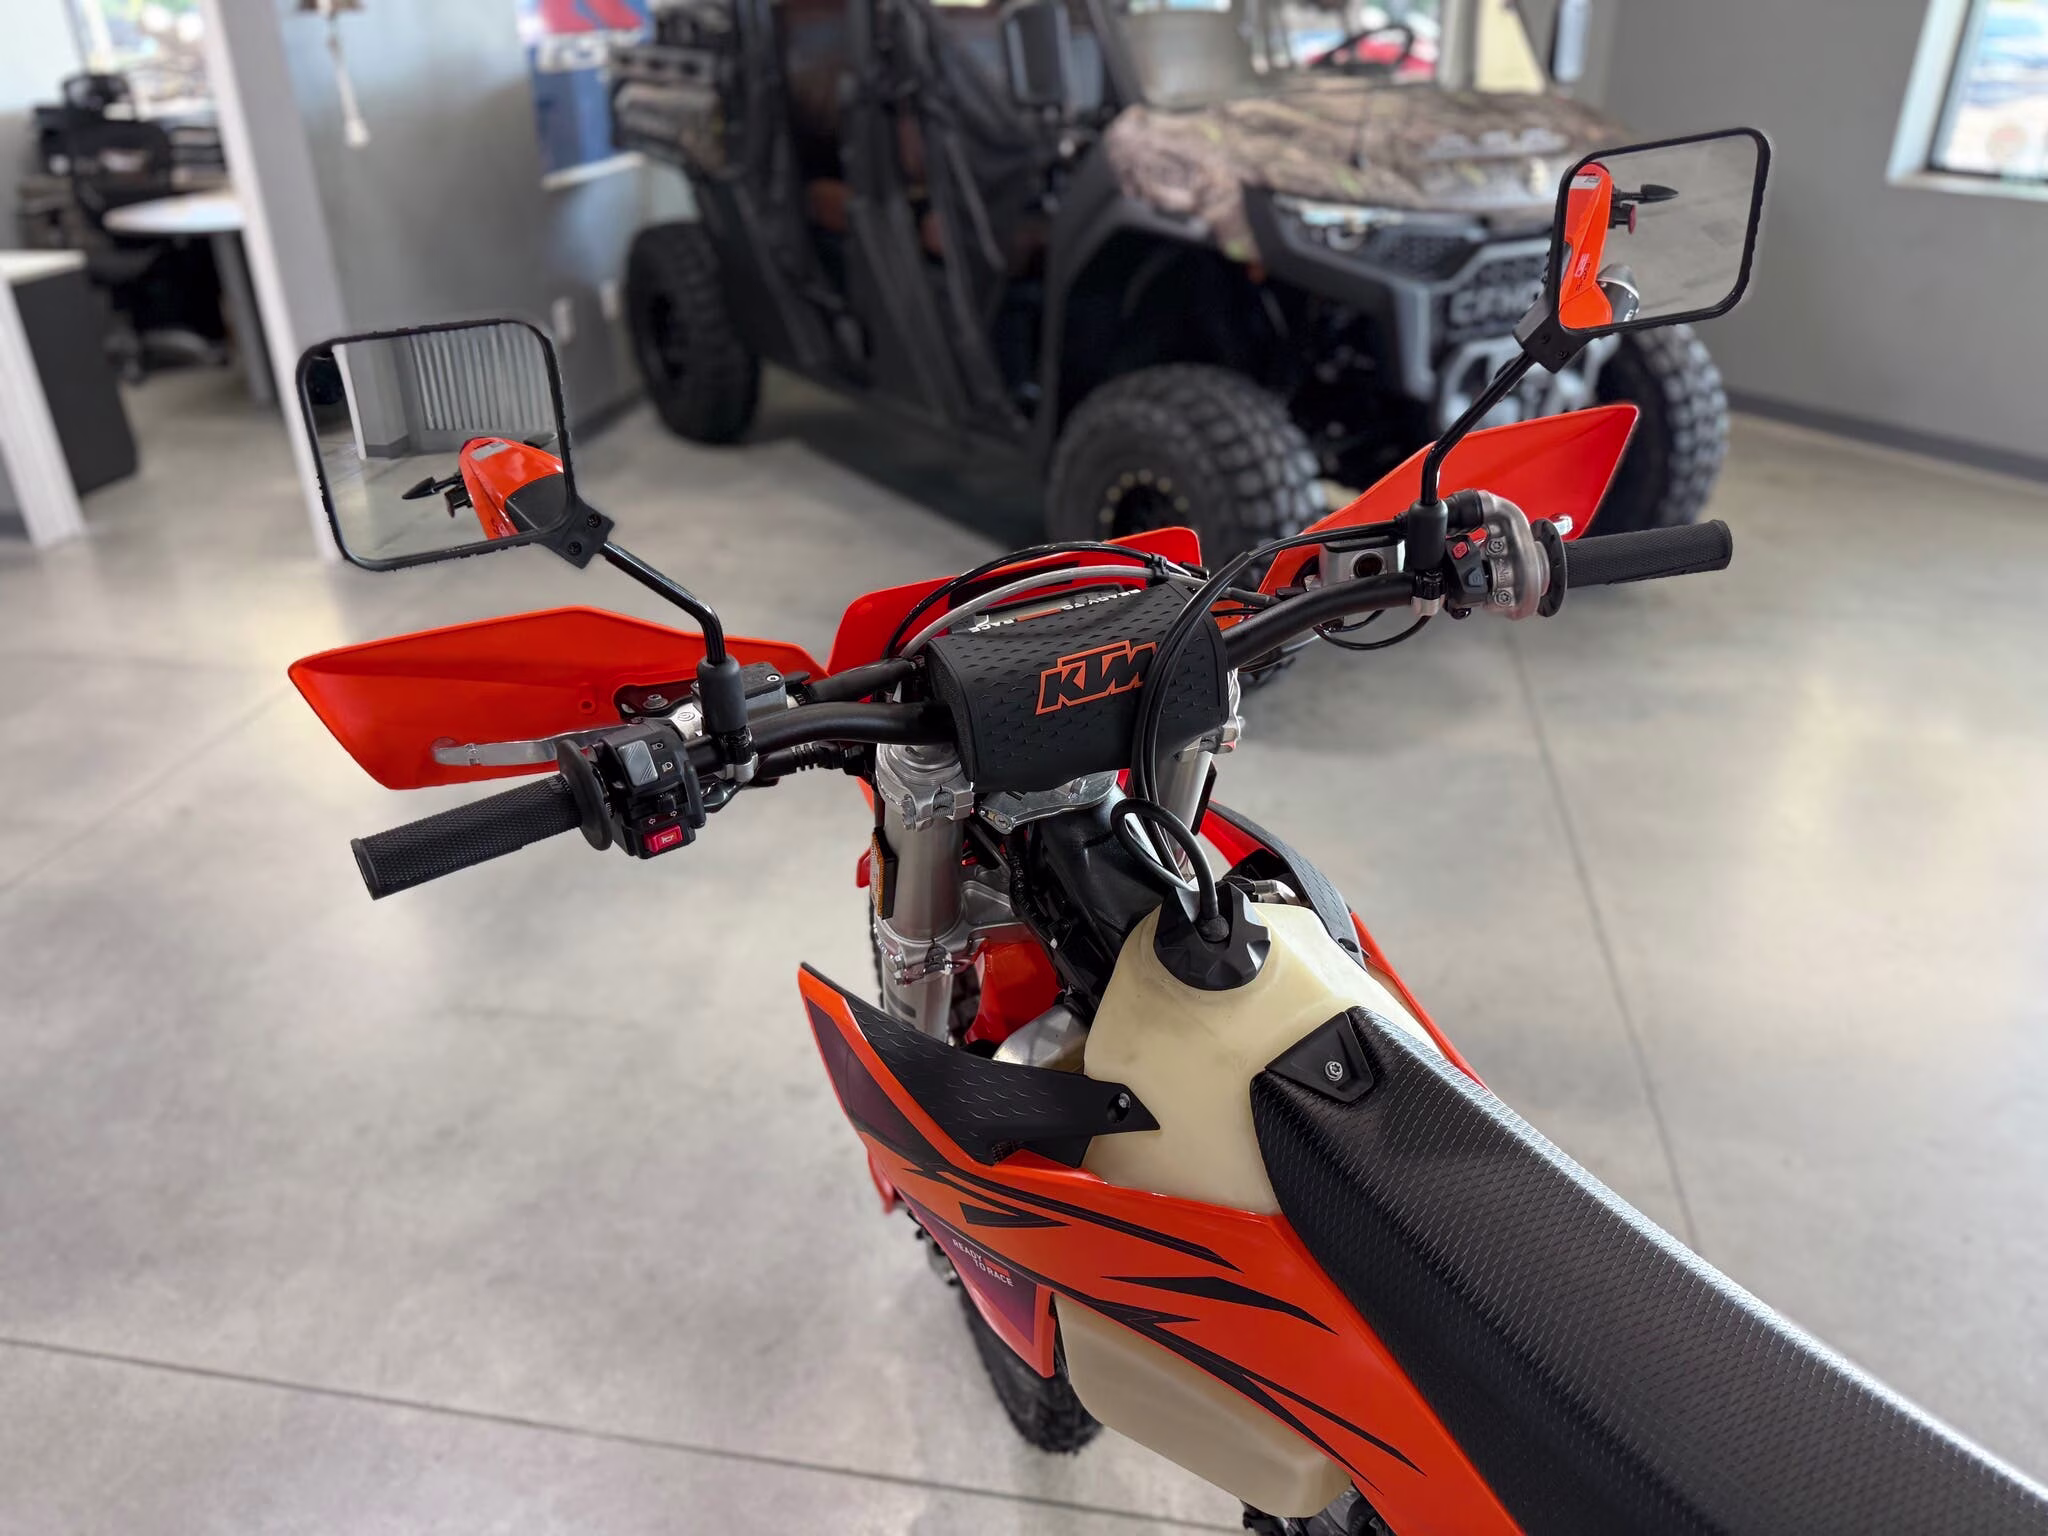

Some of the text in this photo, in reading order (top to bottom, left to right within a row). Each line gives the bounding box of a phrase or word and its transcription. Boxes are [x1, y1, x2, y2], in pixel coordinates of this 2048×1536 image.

[952, 1238, 982, 1262] READY
[973, 1258, 1015, 1287] TO RACE
